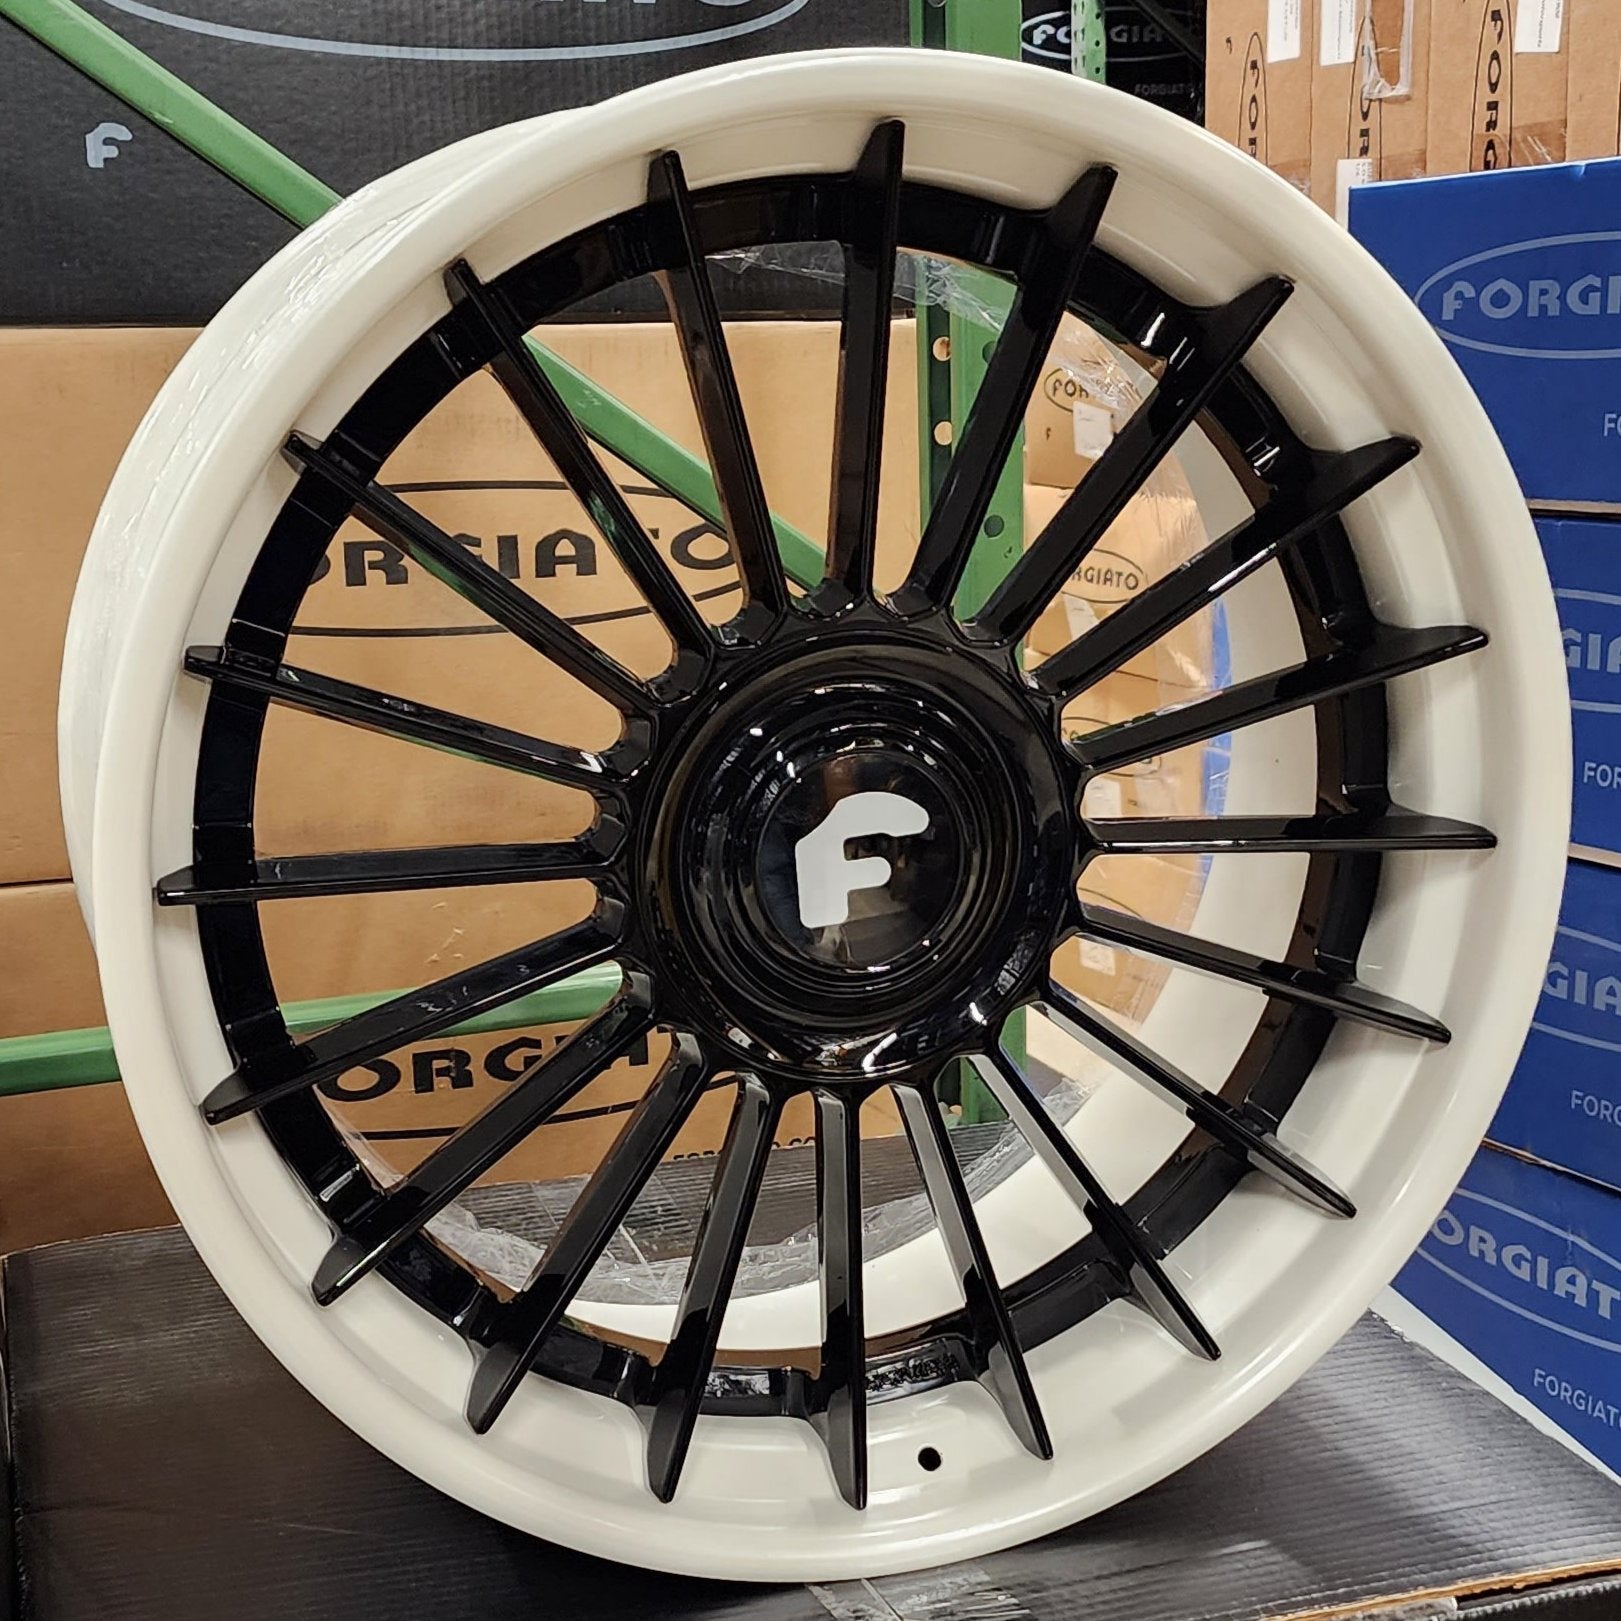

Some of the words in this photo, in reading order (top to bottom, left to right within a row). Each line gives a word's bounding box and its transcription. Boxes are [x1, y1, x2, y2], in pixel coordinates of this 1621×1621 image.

[1033, 24, 1163, 46] FOGIA
[1484, 9, 1504, 170] FORG
[86, 122, 133, 168] F
[1442, 274, 1621, 320] FORGI
[795, 791, 930, 928] F
[1431, 1210, 1621, 1319] ORGIAT
[1533, 1368, 1621, 1428] FORGIAT
